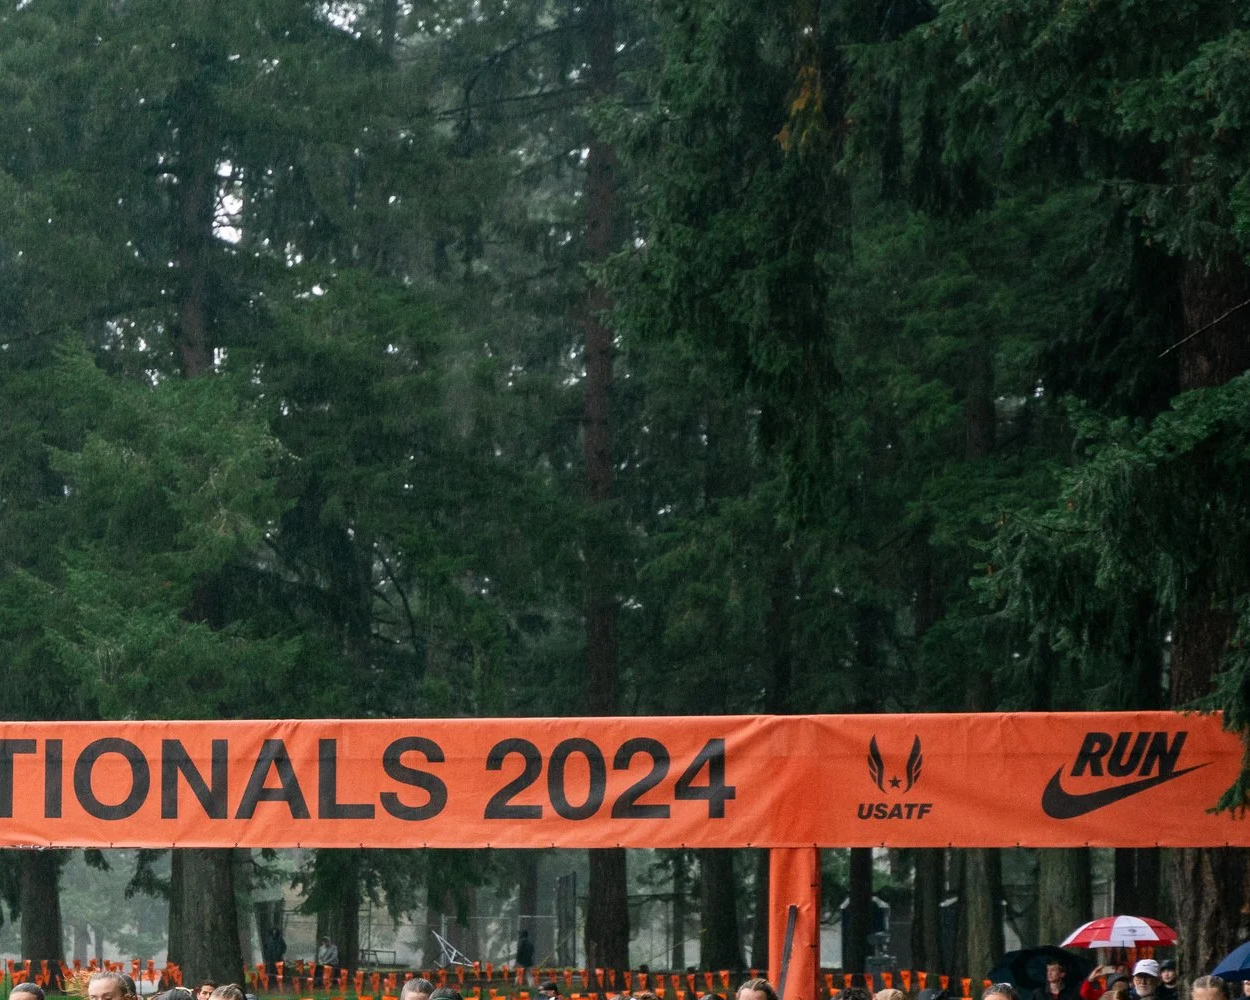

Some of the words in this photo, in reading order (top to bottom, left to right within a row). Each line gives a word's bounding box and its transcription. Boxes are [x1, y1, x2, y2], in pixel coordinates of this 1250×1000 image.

[1071, 731, 1189, 777] RUN
[485, 736, 736, 820] 2024
[857, 803, 933, 820] USATF
